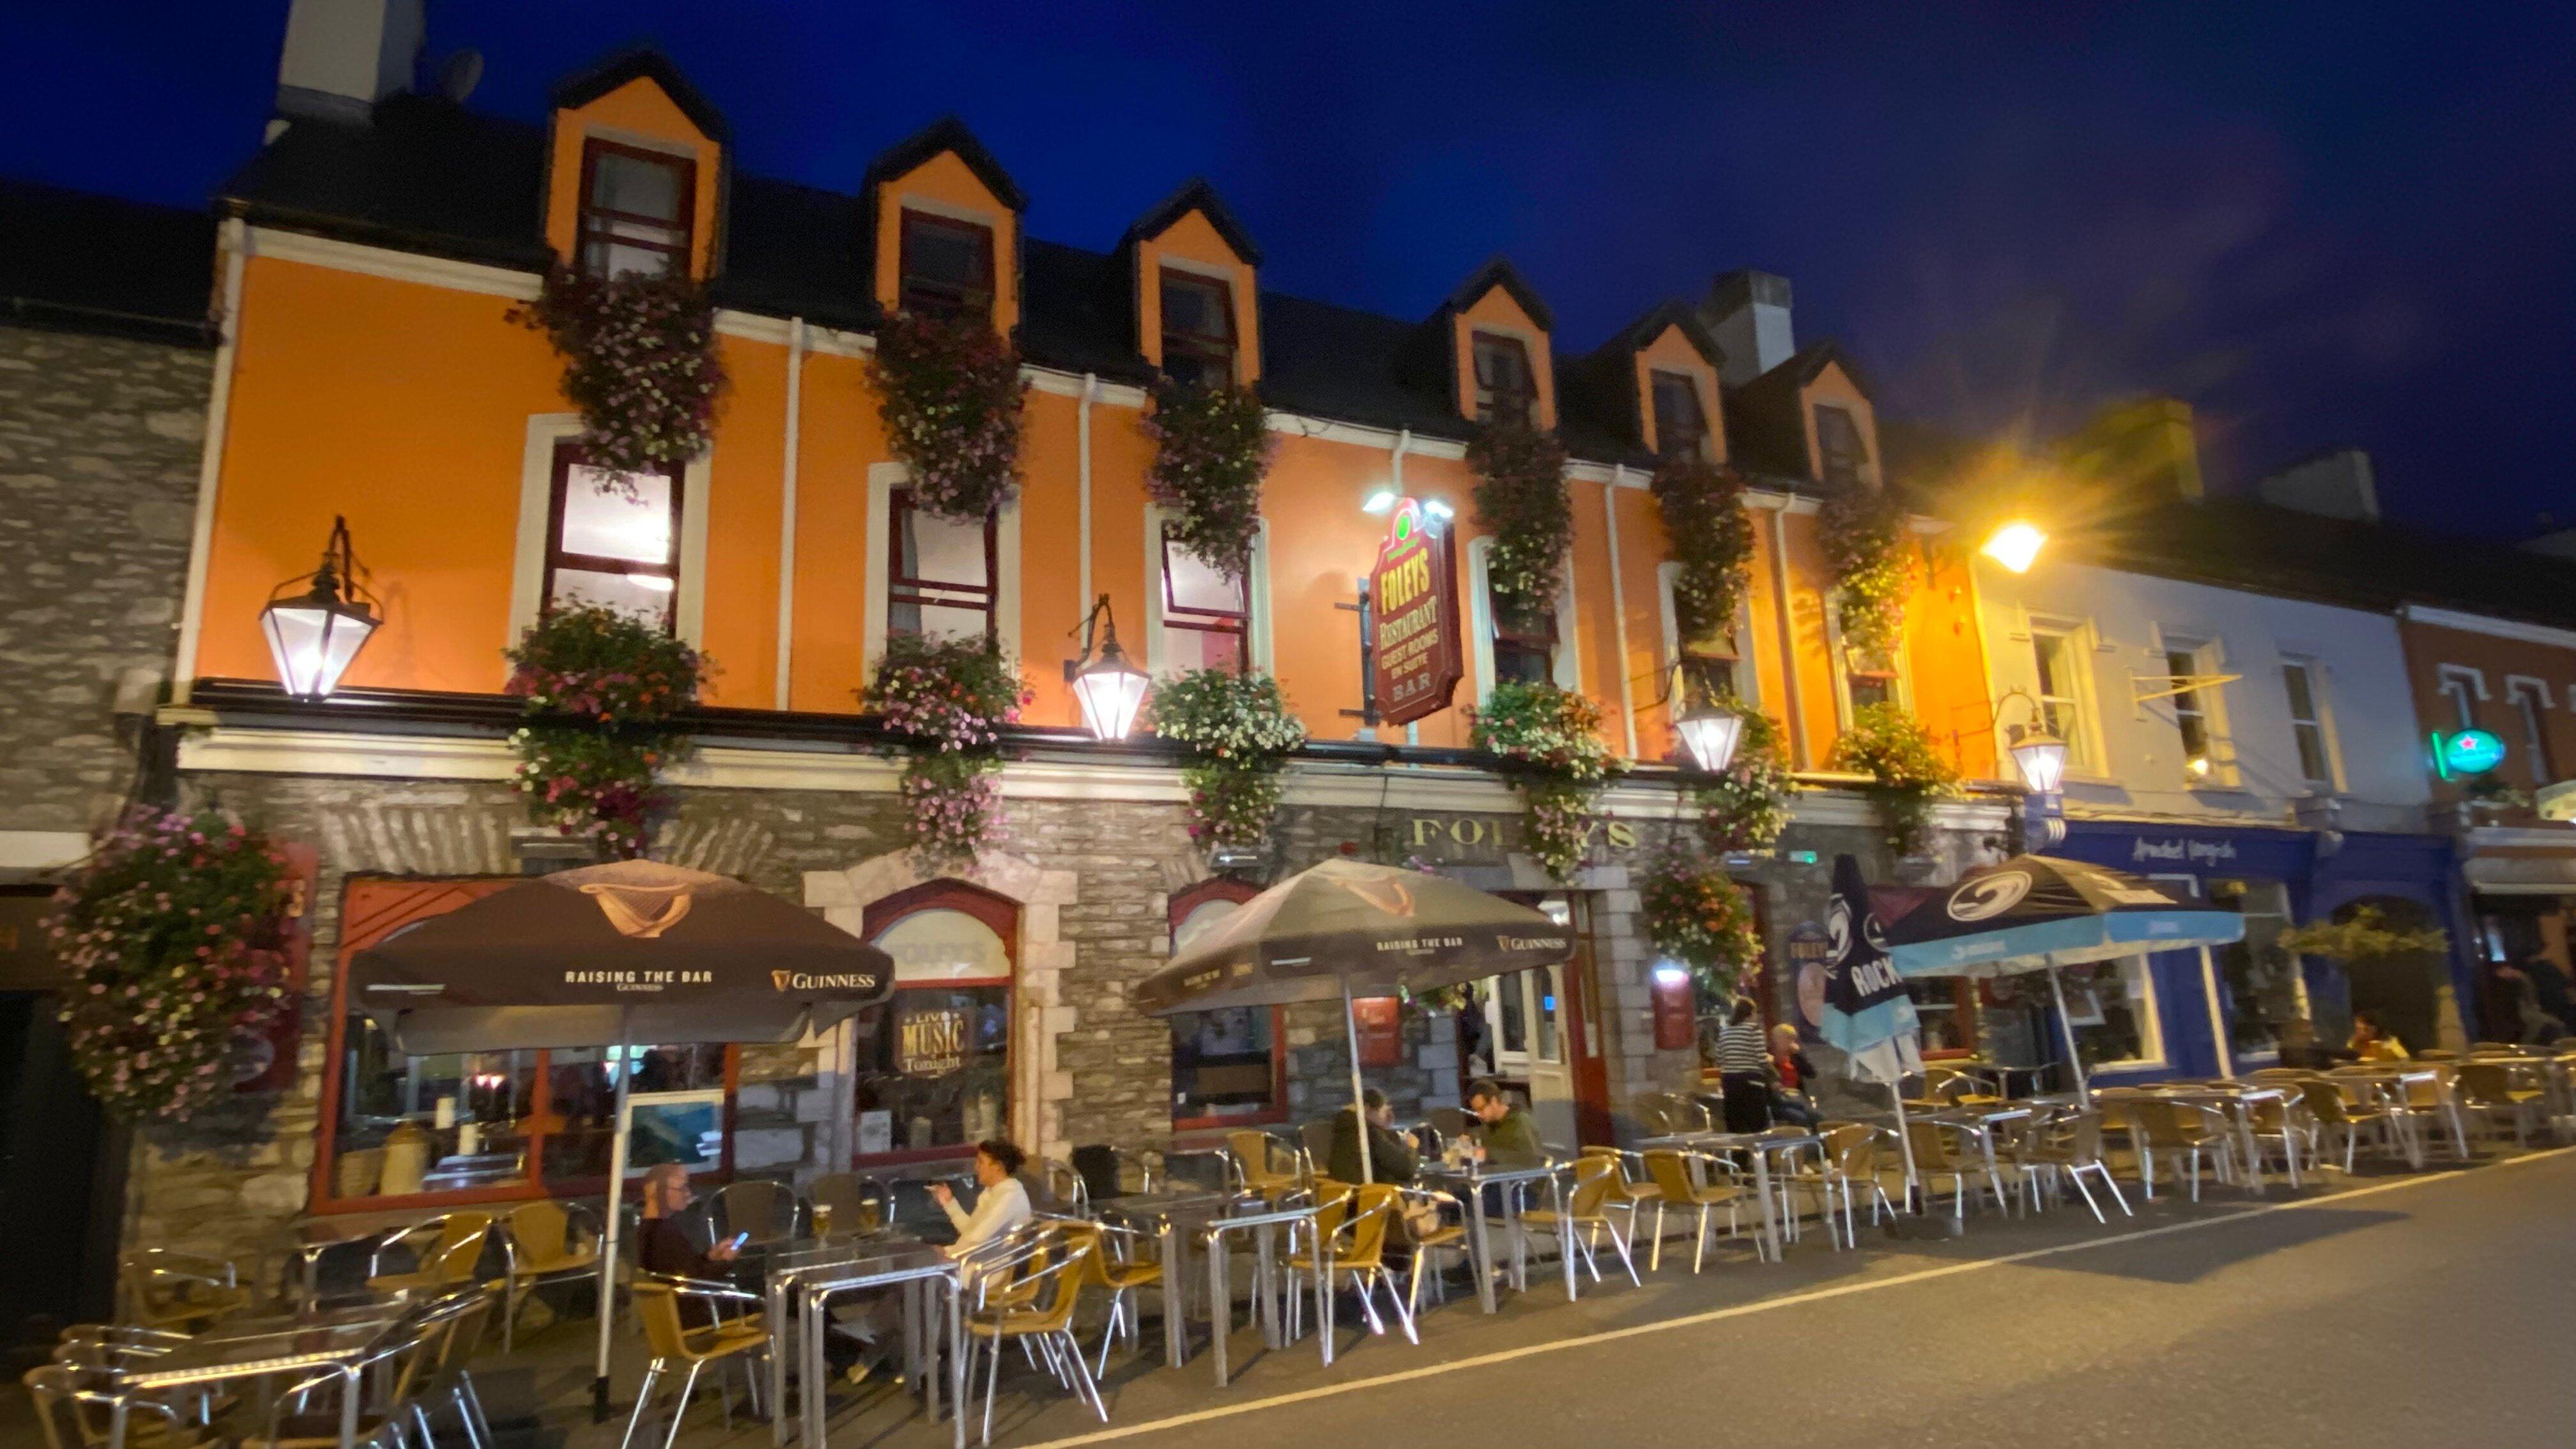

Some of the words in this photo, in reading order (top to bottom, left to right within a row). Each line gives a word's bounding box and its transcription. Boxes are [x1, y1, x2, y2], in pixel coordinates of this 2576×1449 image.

[1381, 547, 1429, 615] FOLEYS
[1380, 595, 1437, 651] RESTAURANT
[1381, 644, 1407, 670] GUEST
[1407, 628, 1438, 657] ROOMS
[1393, 672, 1430, 702] BAR
[1412, 818, 1636, 849] FOLS
[1422, 939, 1439, 947] THE
[1443, 937, 1462, 947] BAR
[1511, 937, 1567, 950] GUINNESS
[565, 971, 636, 983] RAISING
[644, 971, 674, 983] THE
[682, 971, 712, 983] BAR
[792, 973, 875, 989] GUINNESS
[1851, 956, 1903, 997] ROCK
[916, 1011, 951, 1023] LIV
[902, 1020, 964, 1057] MUSIC
[903, 1054, 961, 1076] Tonight
